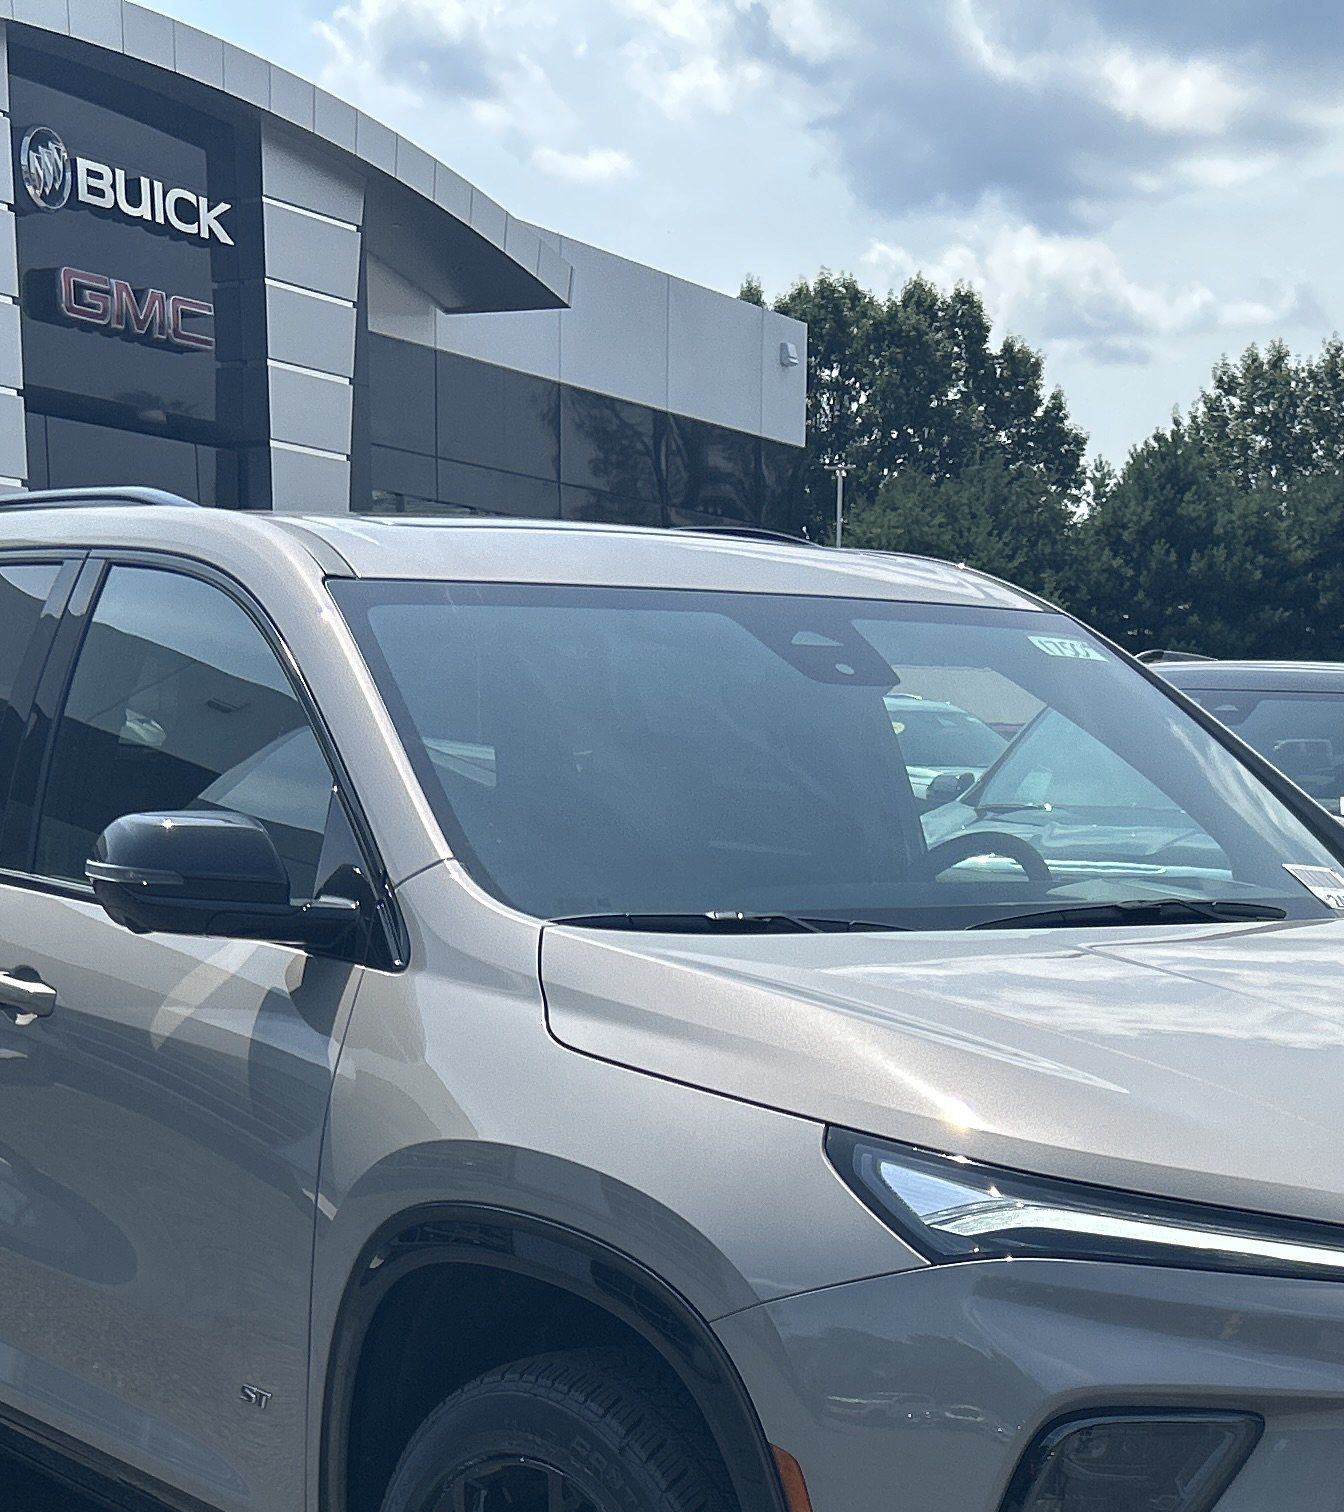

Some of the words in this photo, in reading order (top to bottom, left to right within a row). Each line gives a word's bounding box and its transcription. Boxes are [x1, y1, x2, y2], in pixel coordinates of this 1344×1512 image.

[76, 157, 235, 246] BUICK
[60, 266, 215, 349] GMC
[239, 1383, 272, 1409] ST
